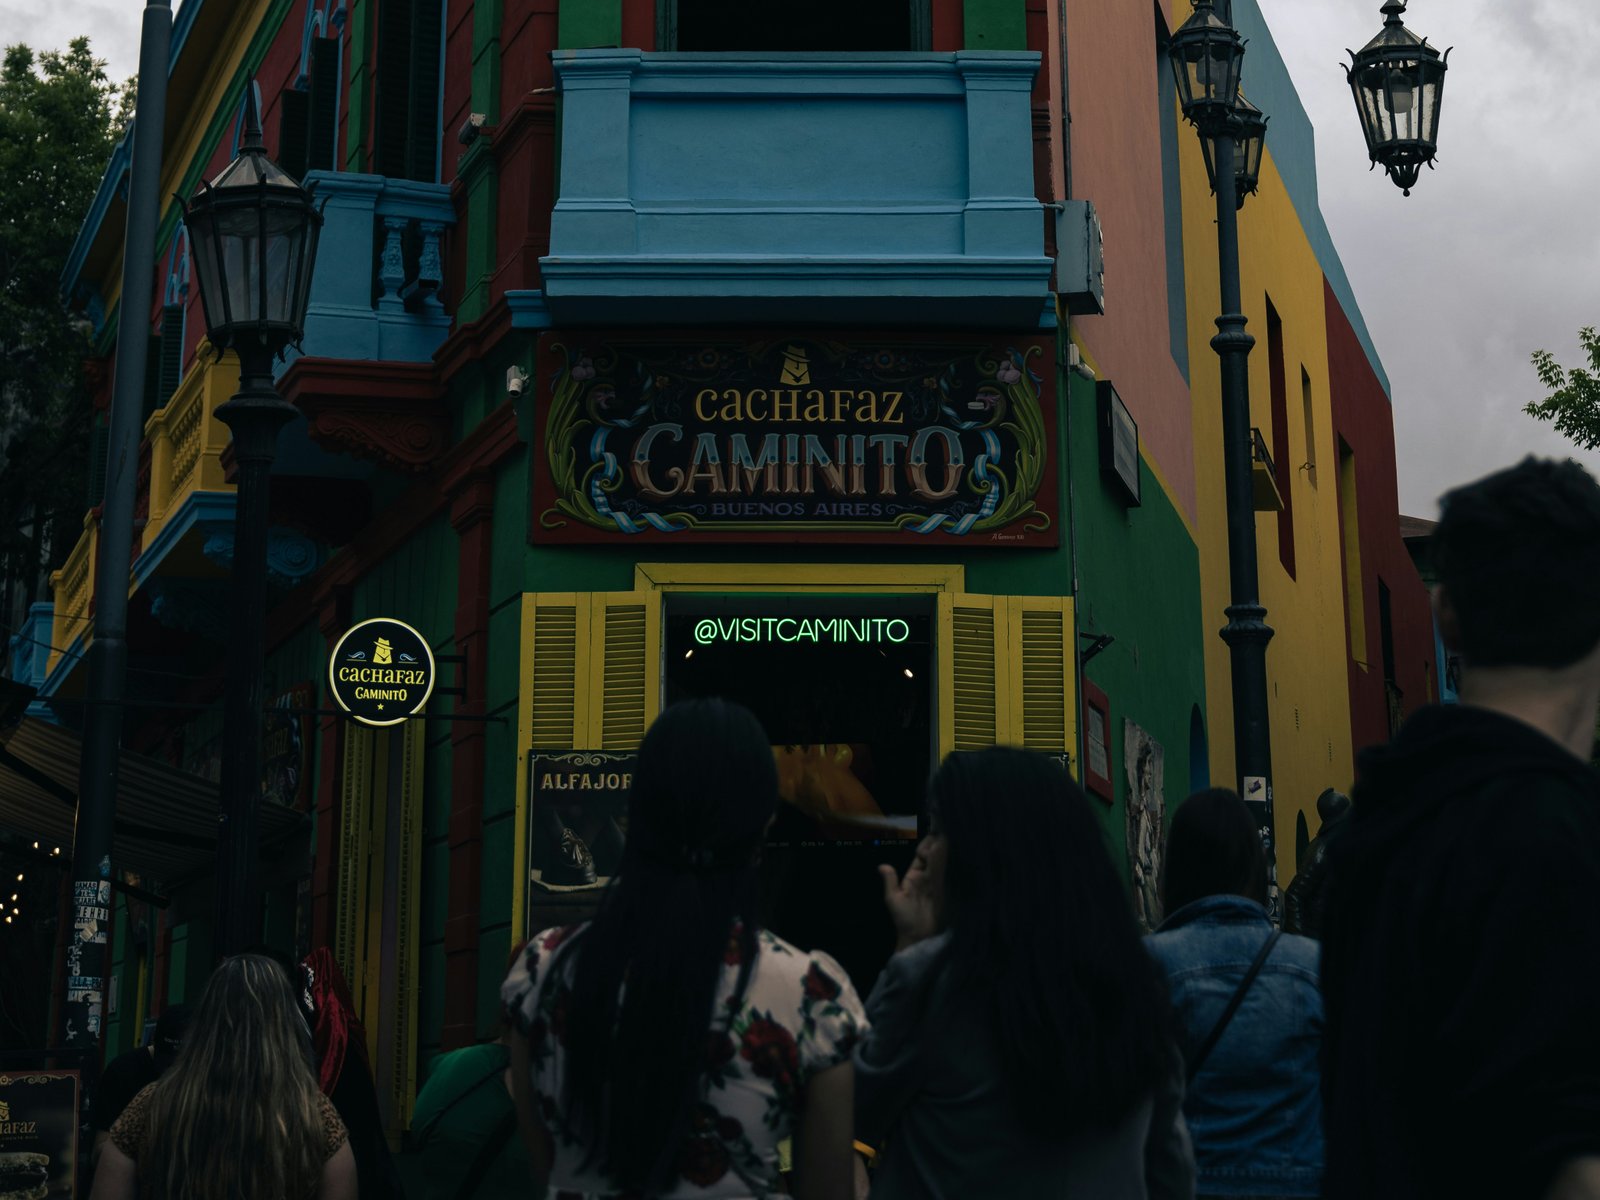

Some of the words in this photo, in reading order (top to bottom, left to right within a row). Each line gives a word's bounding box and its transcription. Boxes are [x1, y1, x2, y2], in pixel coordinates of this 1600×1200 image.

[631, 422, 966, 501] CAMINITO
[710, 502, 806, 517] BUENOS
[813, 502, 882, 517] AIRES
[693, 617, 910, 645] @VISITCAMINITO
[354, 686, 408, 702] CAMINITO
